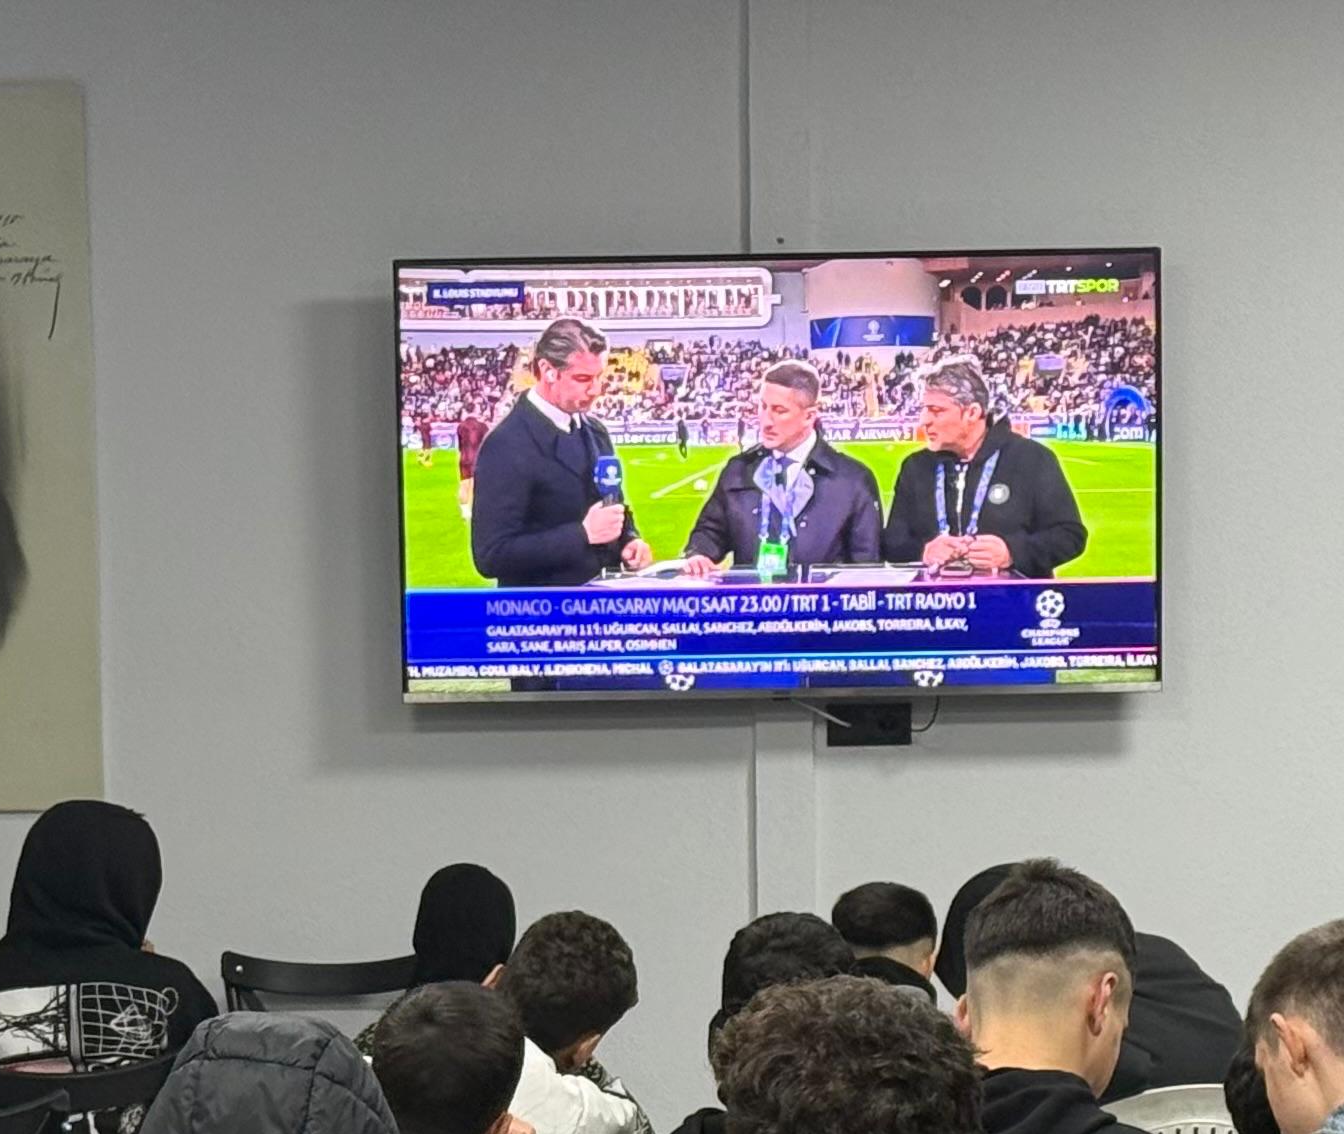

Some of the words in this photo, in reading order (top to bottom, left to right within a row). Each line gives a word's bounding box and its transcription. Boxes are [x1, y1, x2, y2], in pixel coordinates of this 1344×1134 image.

[486, 599, 552, 616] MONACO
[561, 598, 662, 615] GALATASARAY
[662, 596, 699, 617] MAÇI
[701, 596, 738, 614] SAAT
[739, 595, 782, 613] 23.00
[791, 594, 819, 612] TRT
[821, 594, 830, 612] 1
[885, 593, 915, 610] TRT
[916, 592, 966, 610] RADYO
[967, 592, 977, 609] 1
